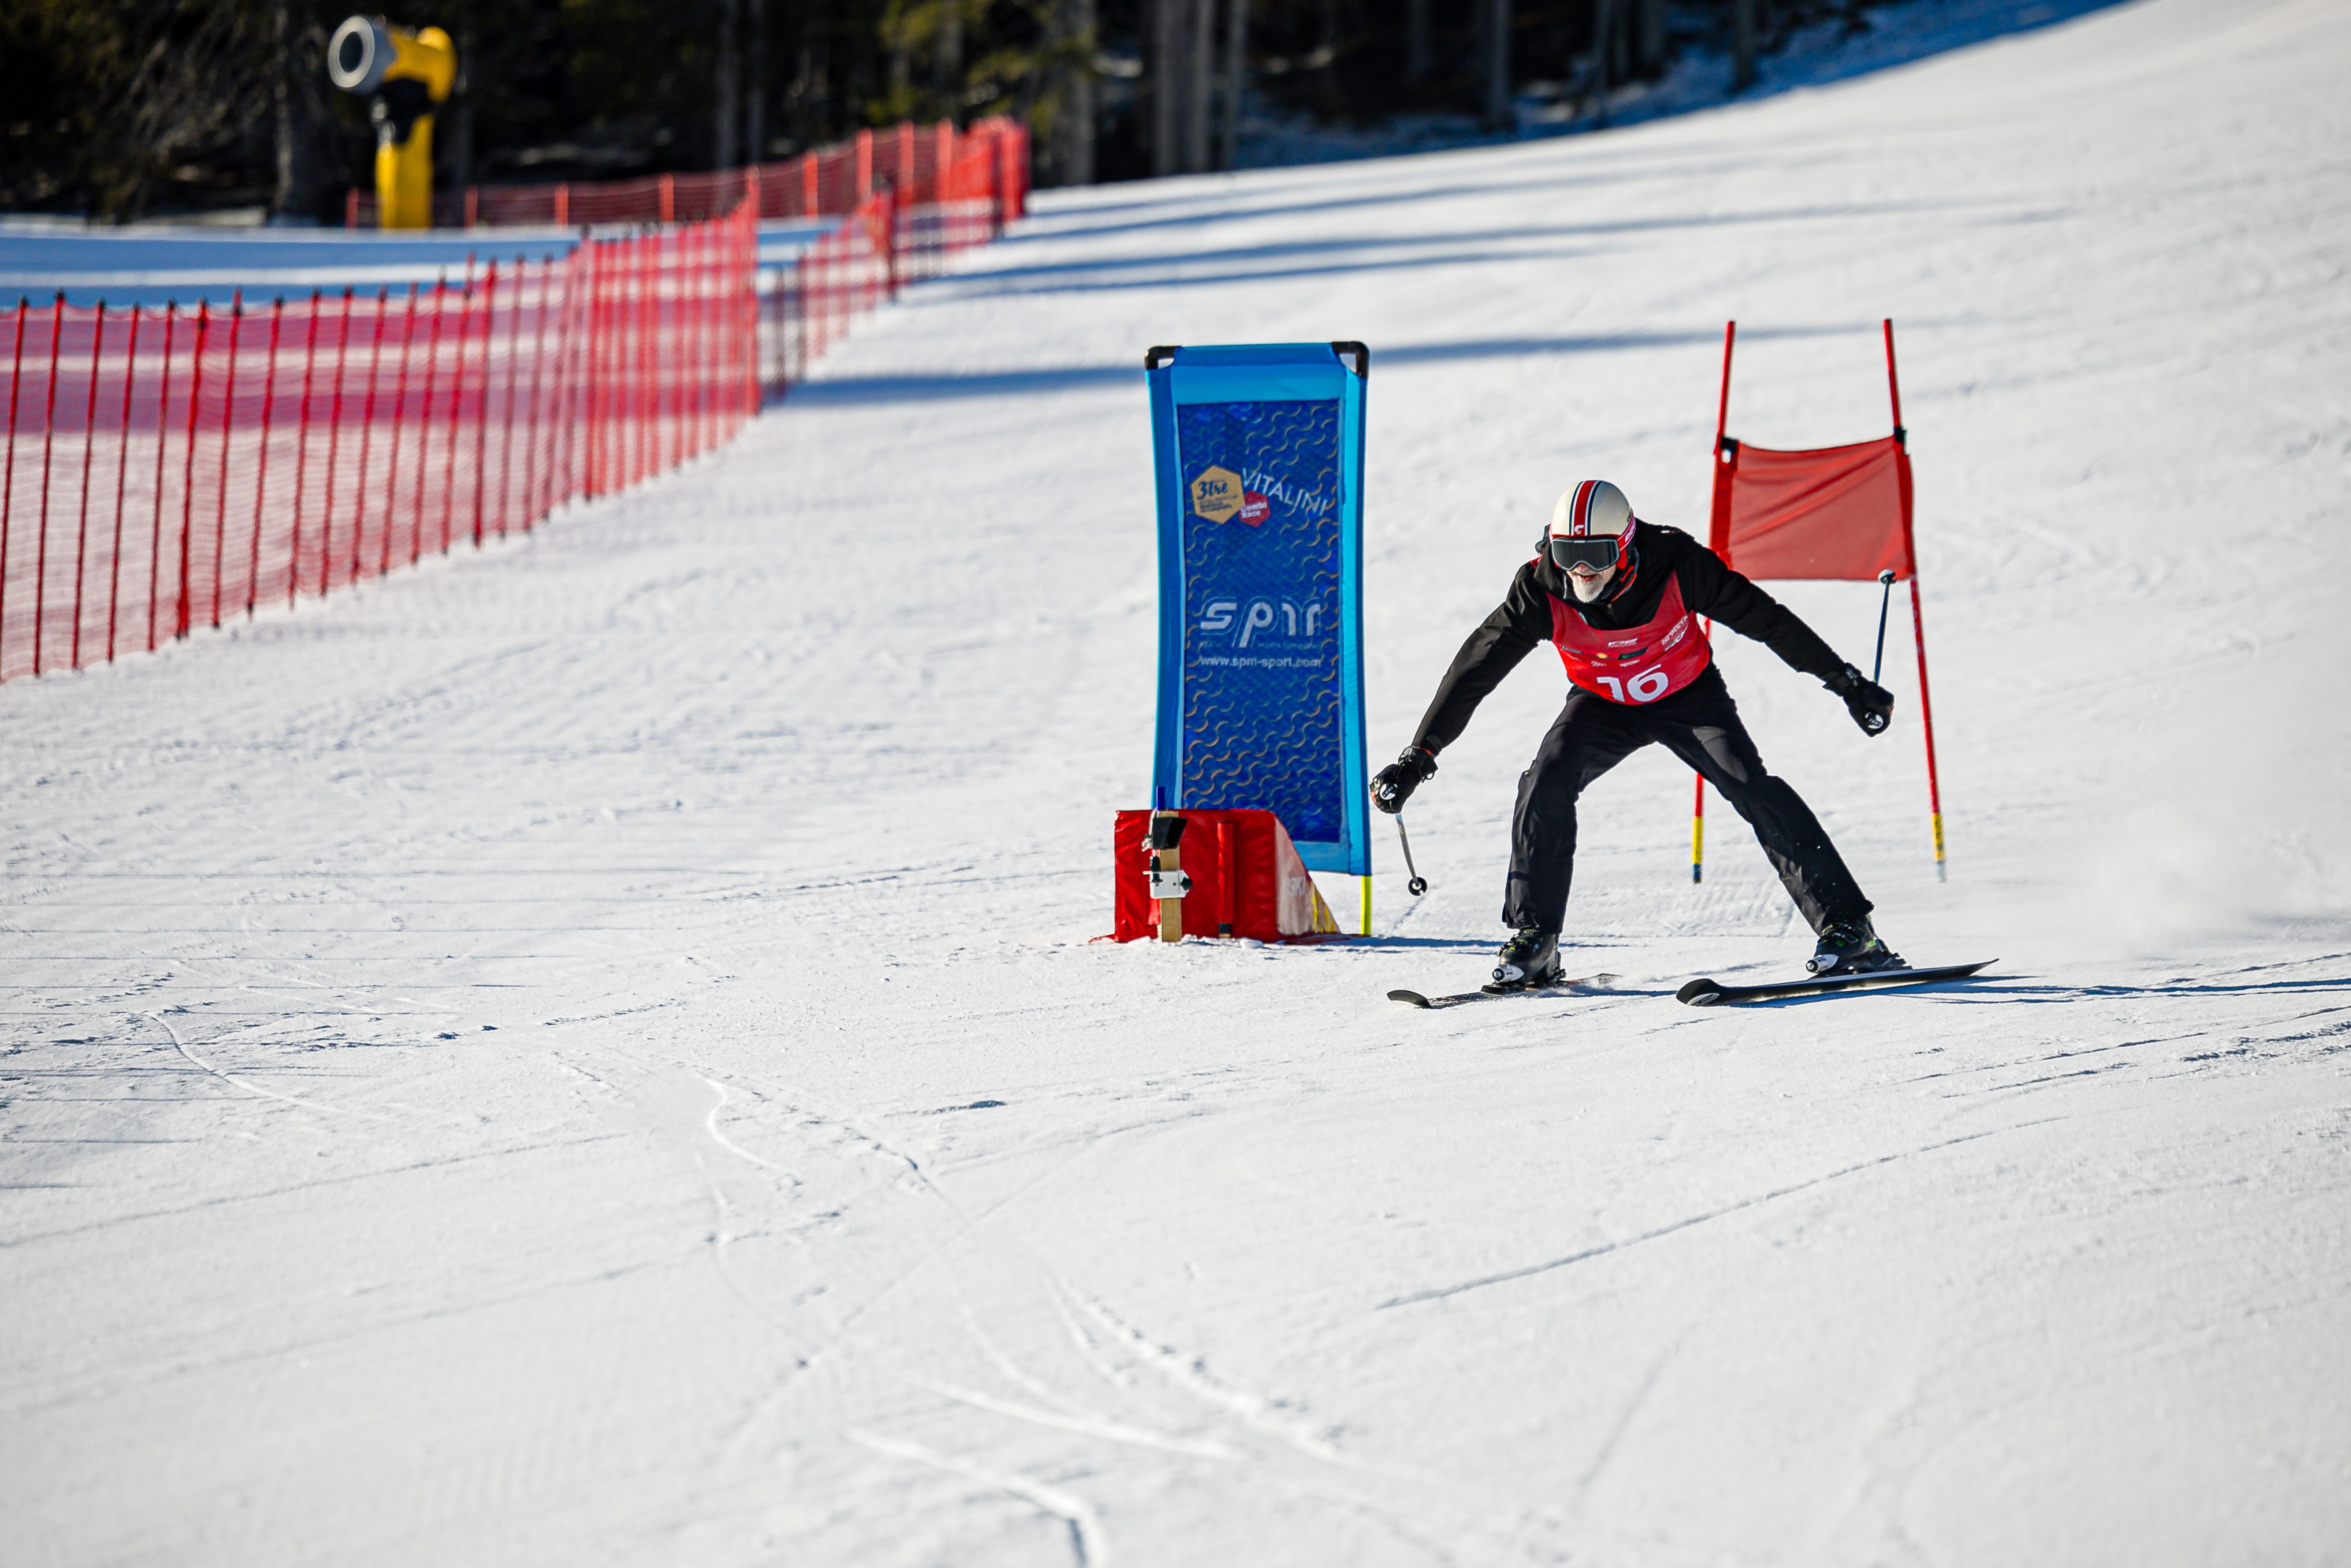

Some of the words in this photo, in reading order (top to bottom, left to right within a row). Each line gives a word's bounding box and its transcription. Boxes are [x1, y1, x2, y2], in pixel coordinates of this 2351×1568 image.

[1242, 467, 1328, 516] VITALINI
[1200, 657, 1322, 669] www.spm-sport.com
[1596, 663, 1669, 702] 16
